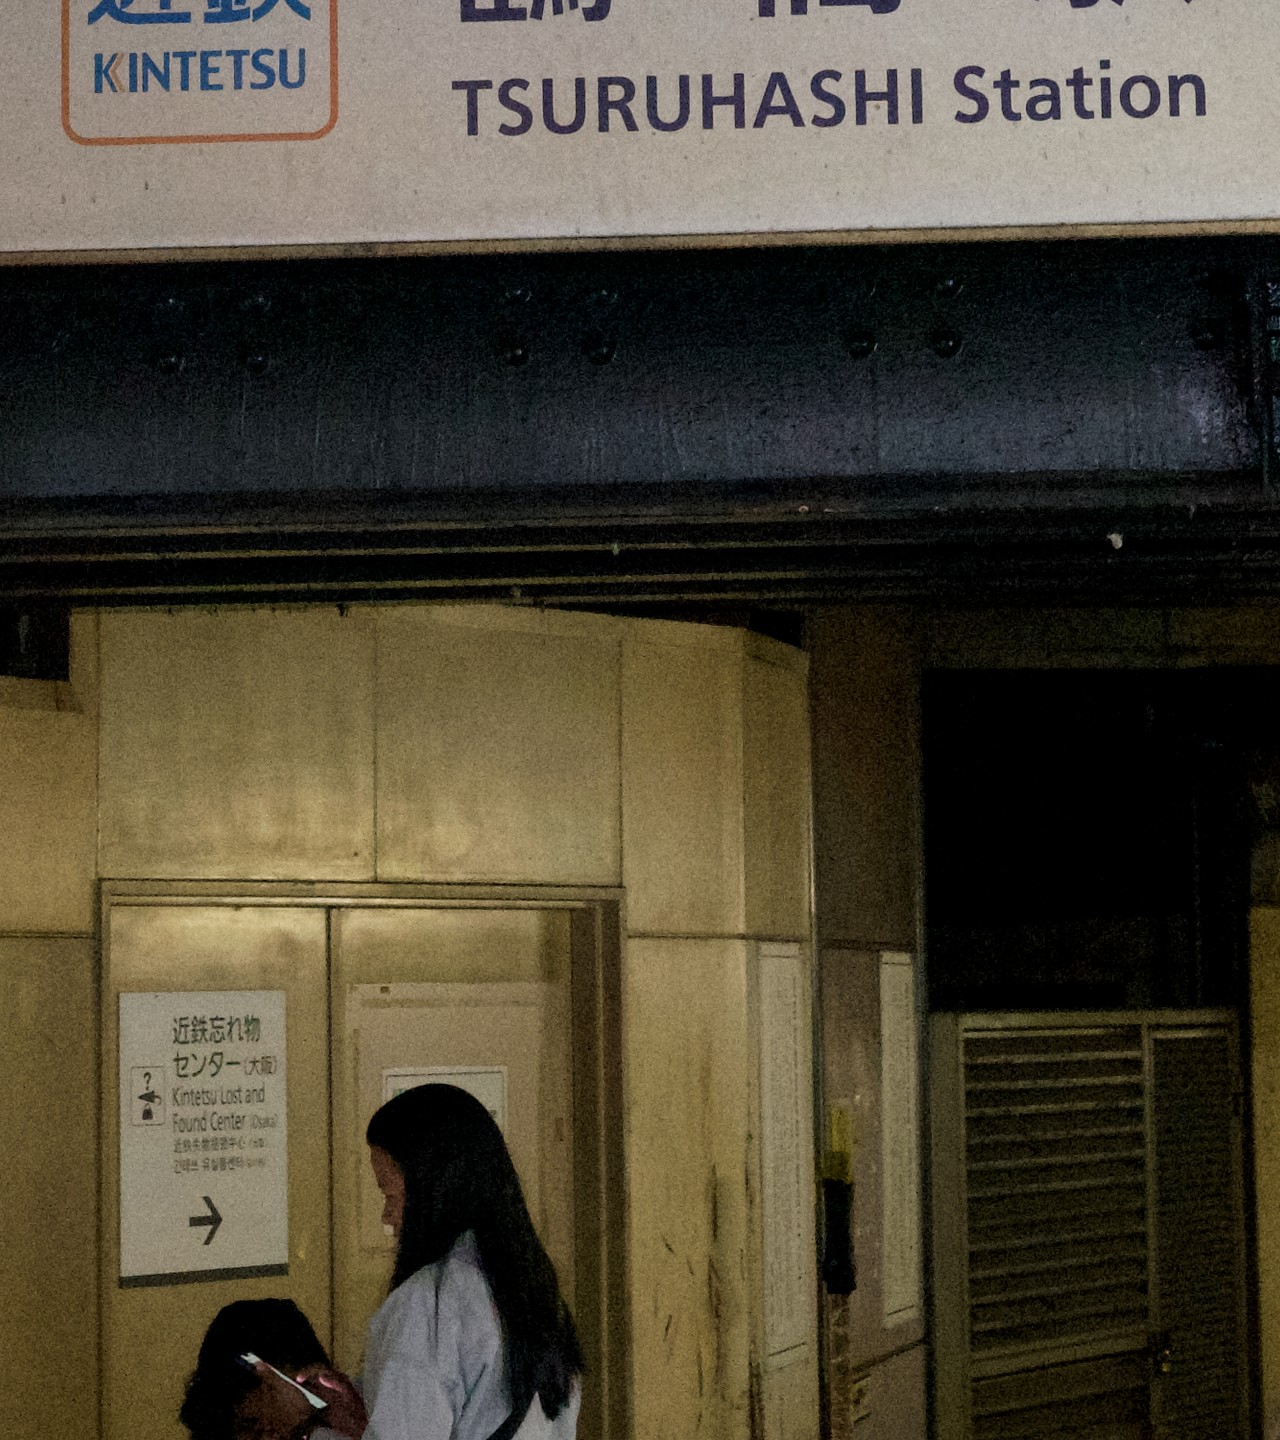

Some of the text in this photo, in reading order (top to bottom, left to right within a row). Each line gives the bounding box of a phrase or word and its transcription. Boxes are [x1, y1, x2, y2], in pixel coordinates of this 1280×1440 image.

[92, 44, 308, 97] KINTETSU
[453, 59, 1209, 138] TSURUHASHI Station
[173, 1015, 261, 1045] 近鉄忘れ物
[172, 1082, 265, 1107] Kintetsu Lost and
[173, 1112, 207, 1134] Found
[210, 1113, 246, 1132] Center
